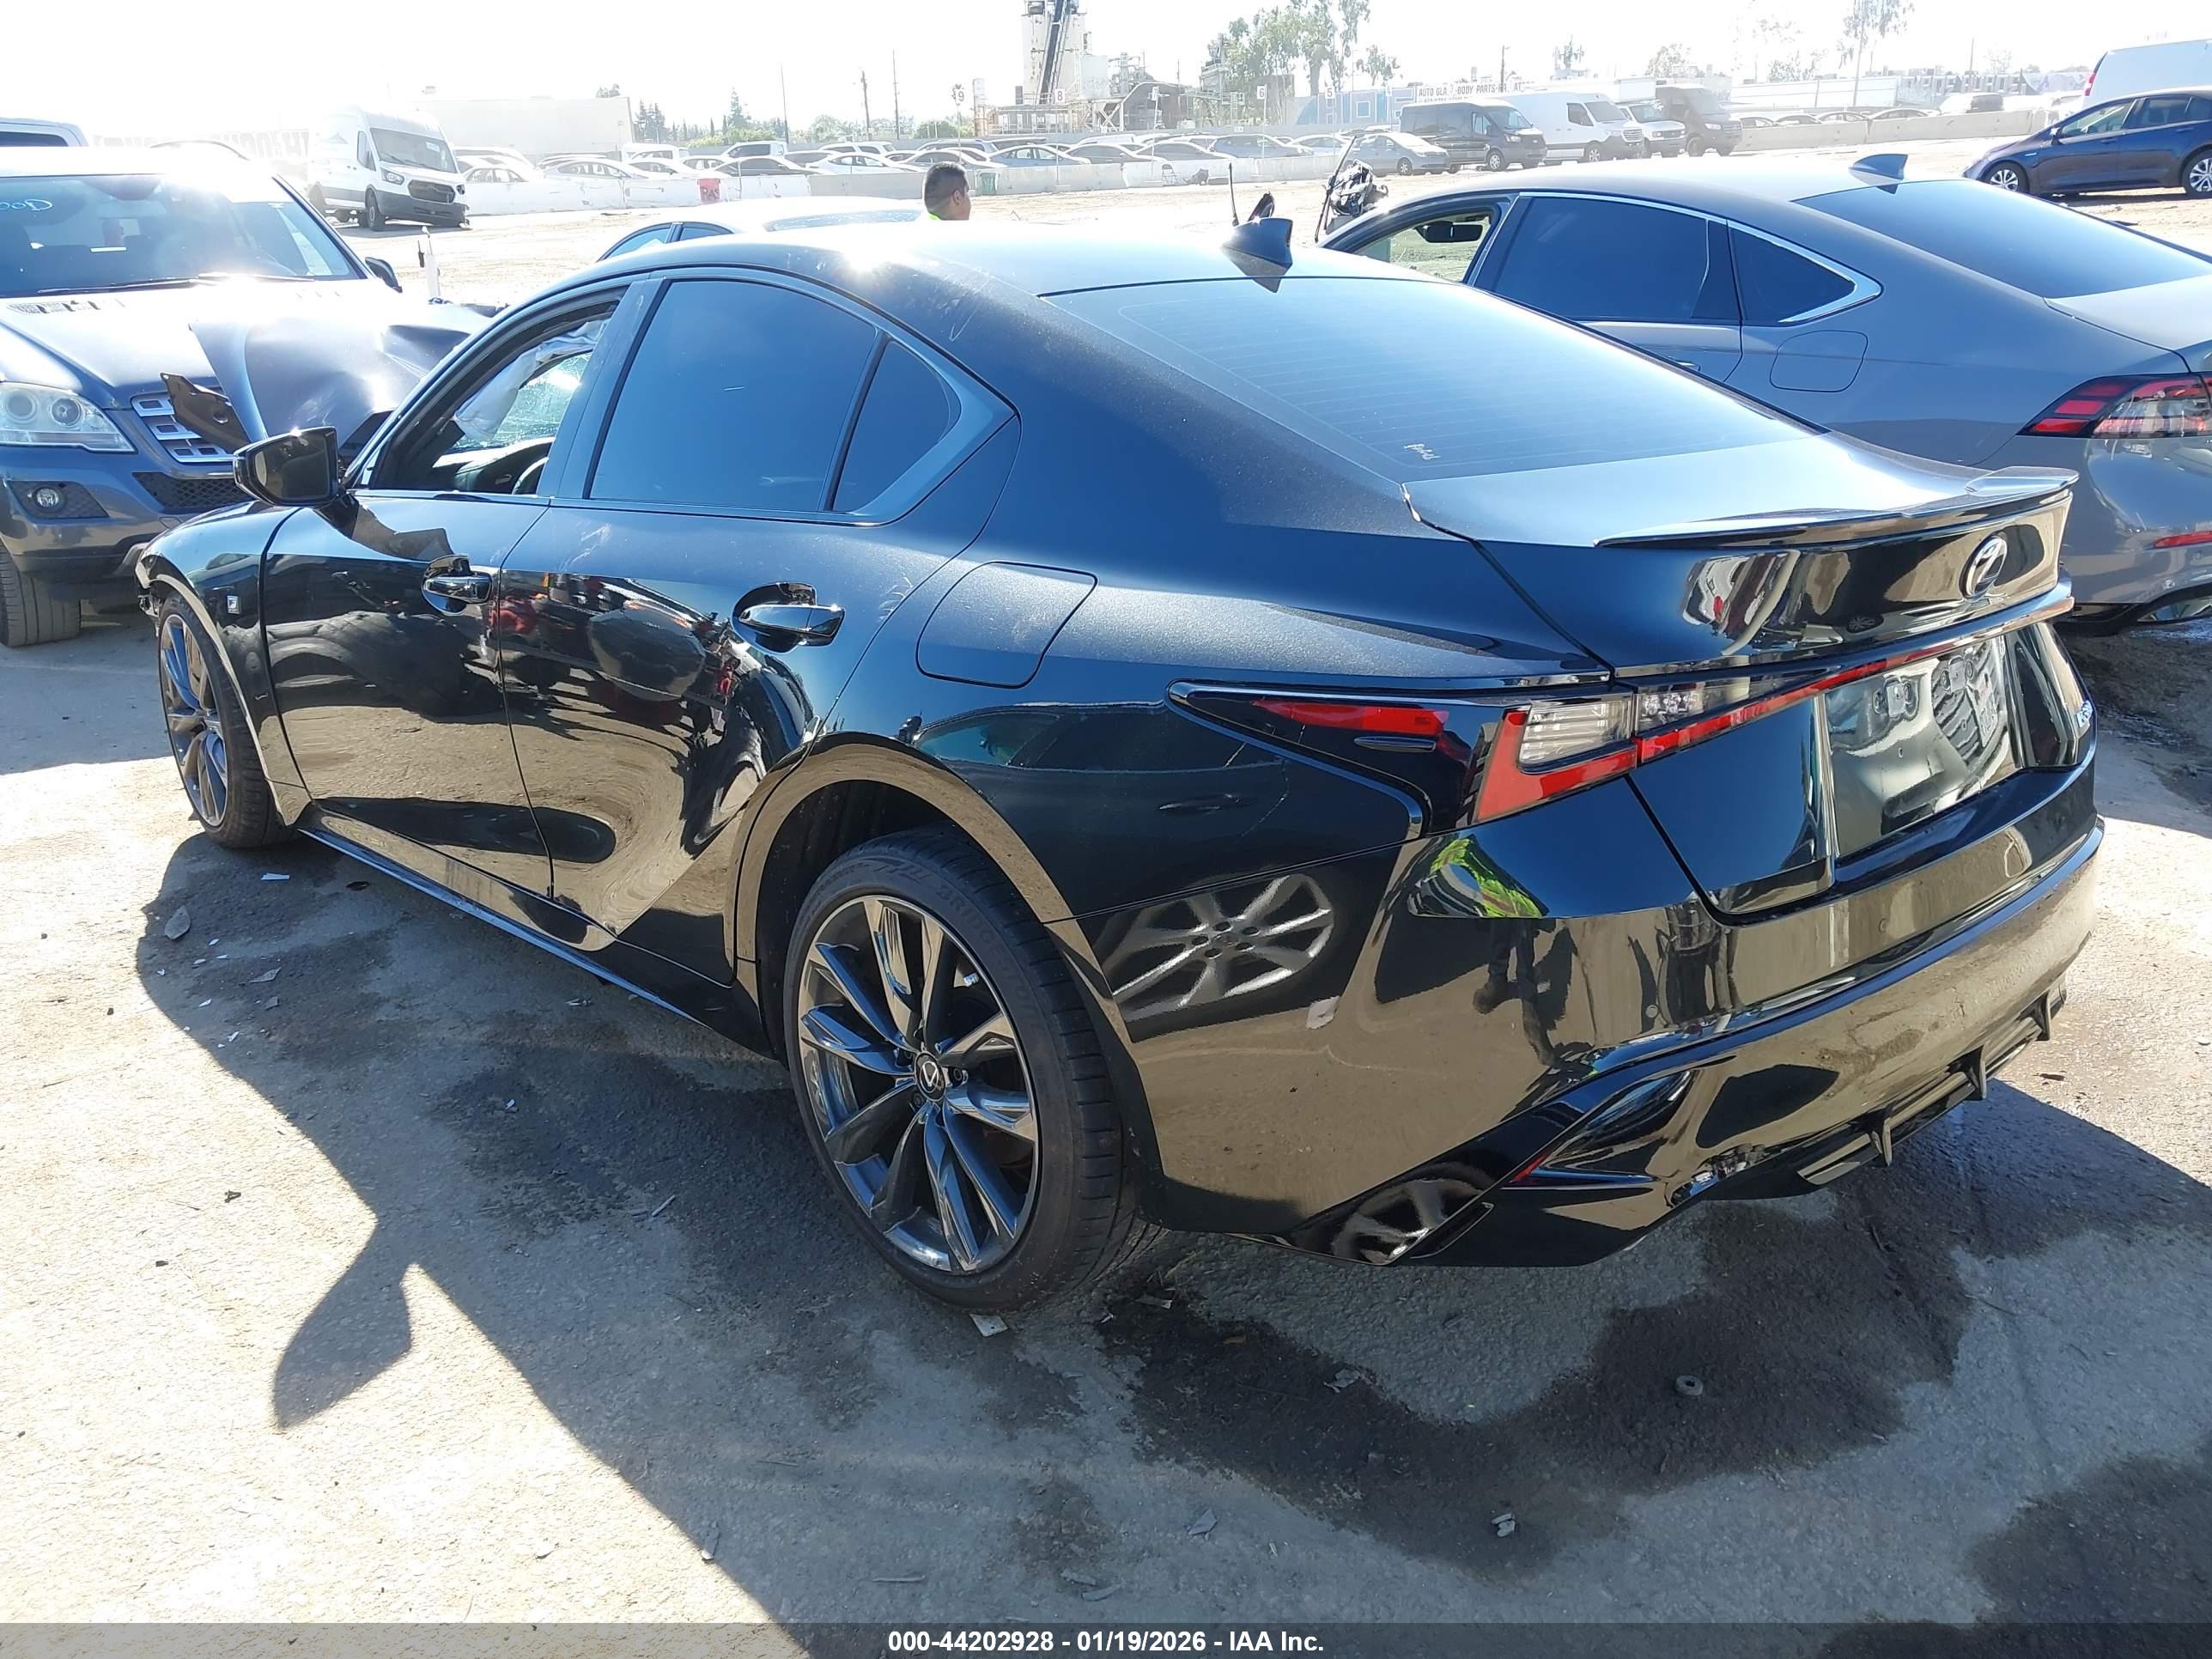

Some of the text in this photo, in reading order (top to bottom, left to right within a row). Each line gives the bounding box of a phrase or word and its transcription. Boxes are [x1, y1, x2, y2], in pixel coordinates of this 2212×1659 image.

[957, 90, 964, 102] 9
[1056, 90, 1064, 101] 8
[1259, 88, 1265, 98] 6
[1327, 88, 1333, 97] 5
[1419, 87, 1434, 97] AUTO
